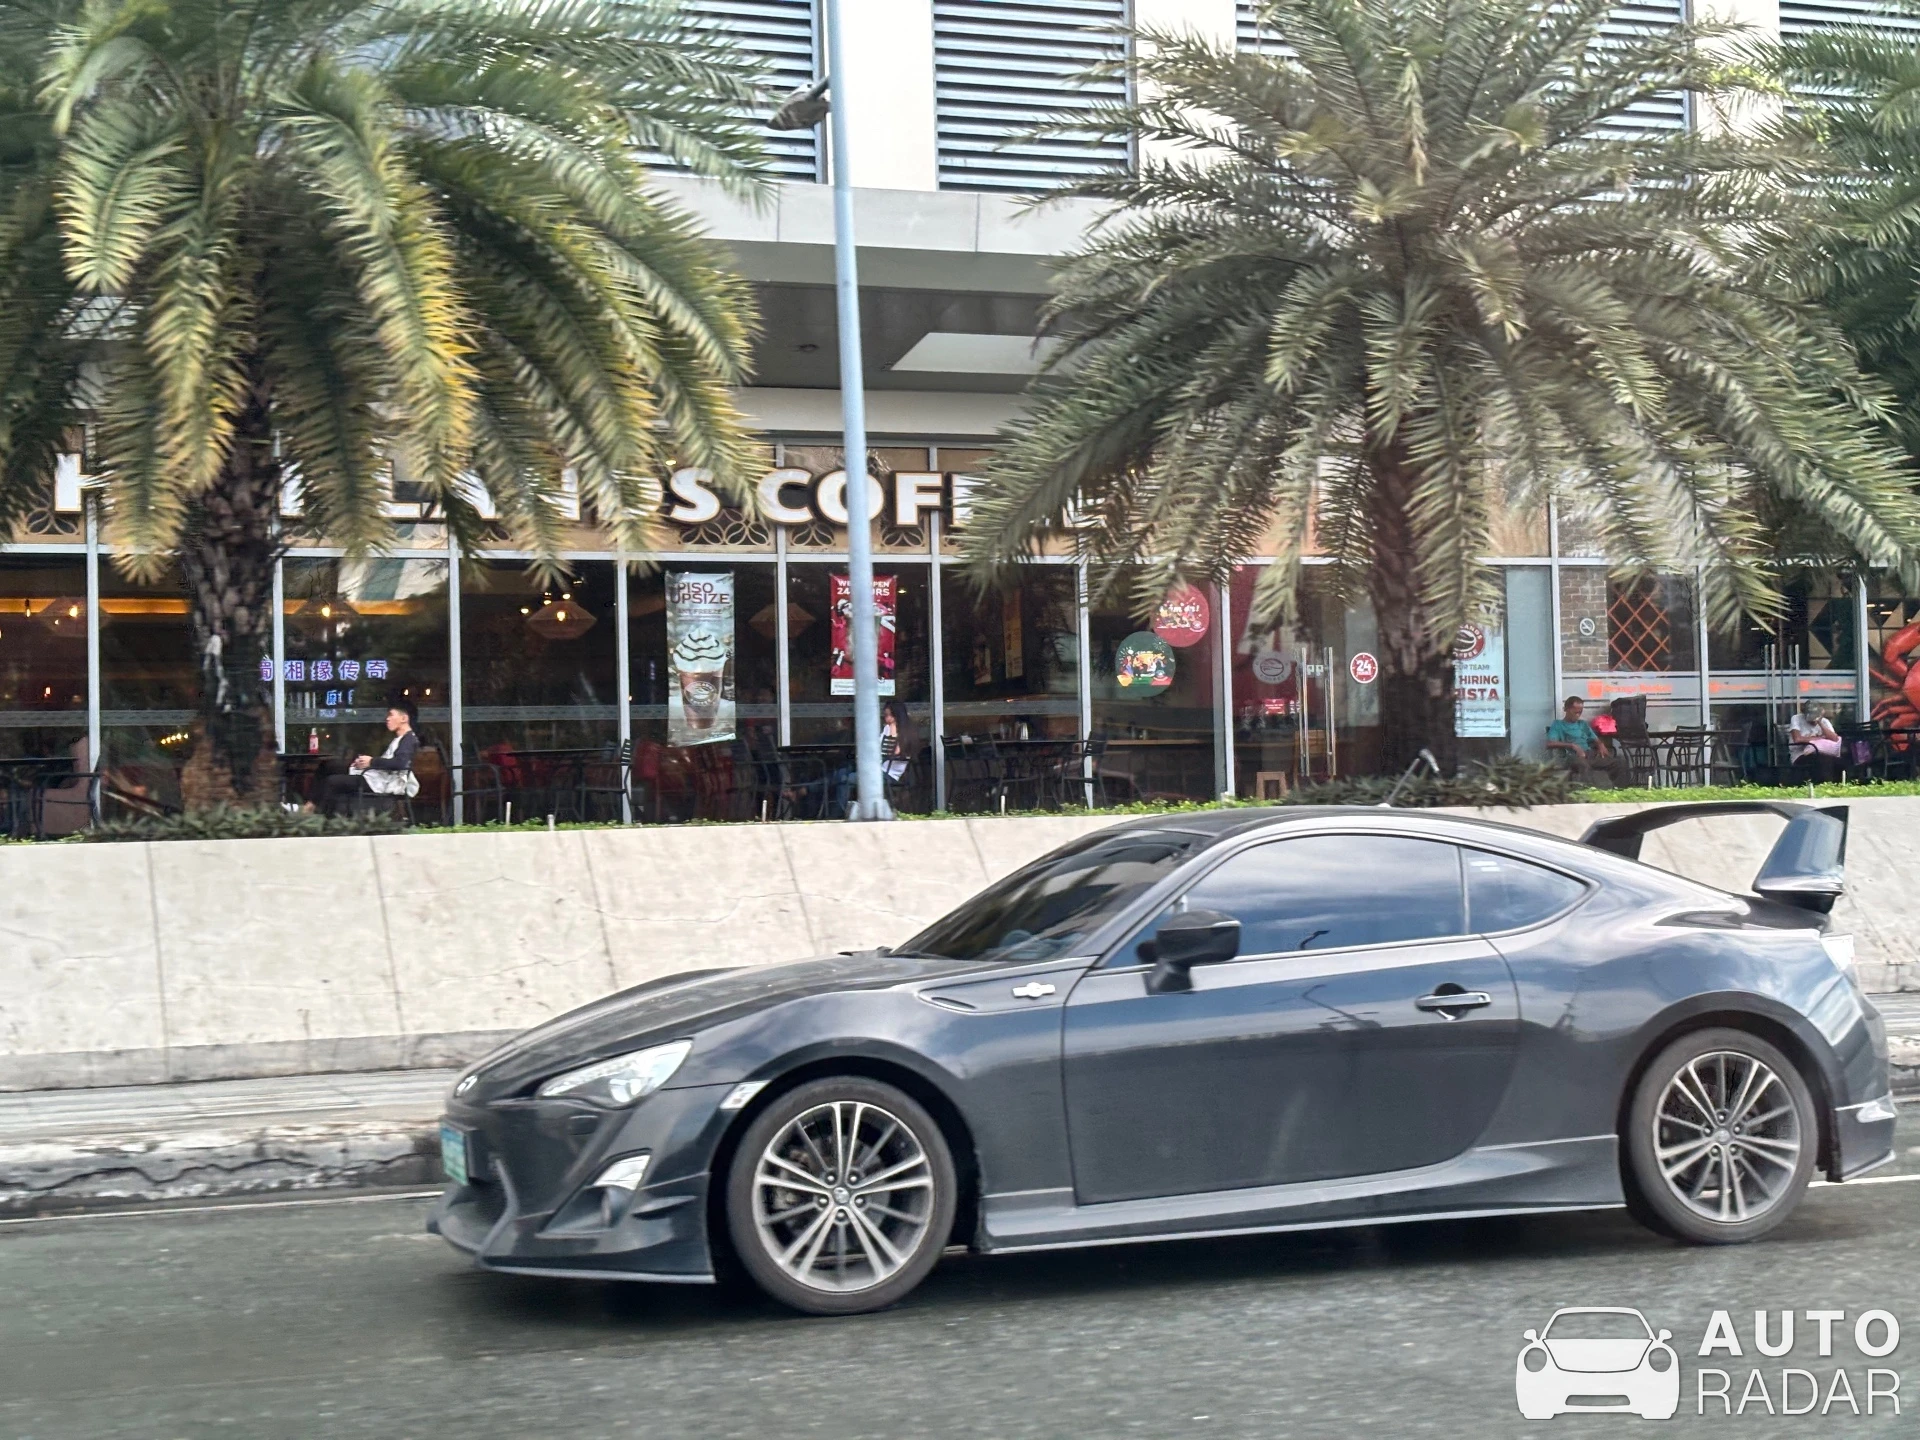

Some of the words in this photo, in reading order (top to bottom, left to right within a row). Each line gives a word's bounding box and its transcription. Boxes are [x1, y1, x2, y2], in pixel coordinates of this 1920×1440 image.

[677, 582, 714, 594] PISO
[670, 593, 730, 604] UPSIZE
[1356, 659, 1372, 673] 24
[1459, 675, 1499, 685] HIRING
